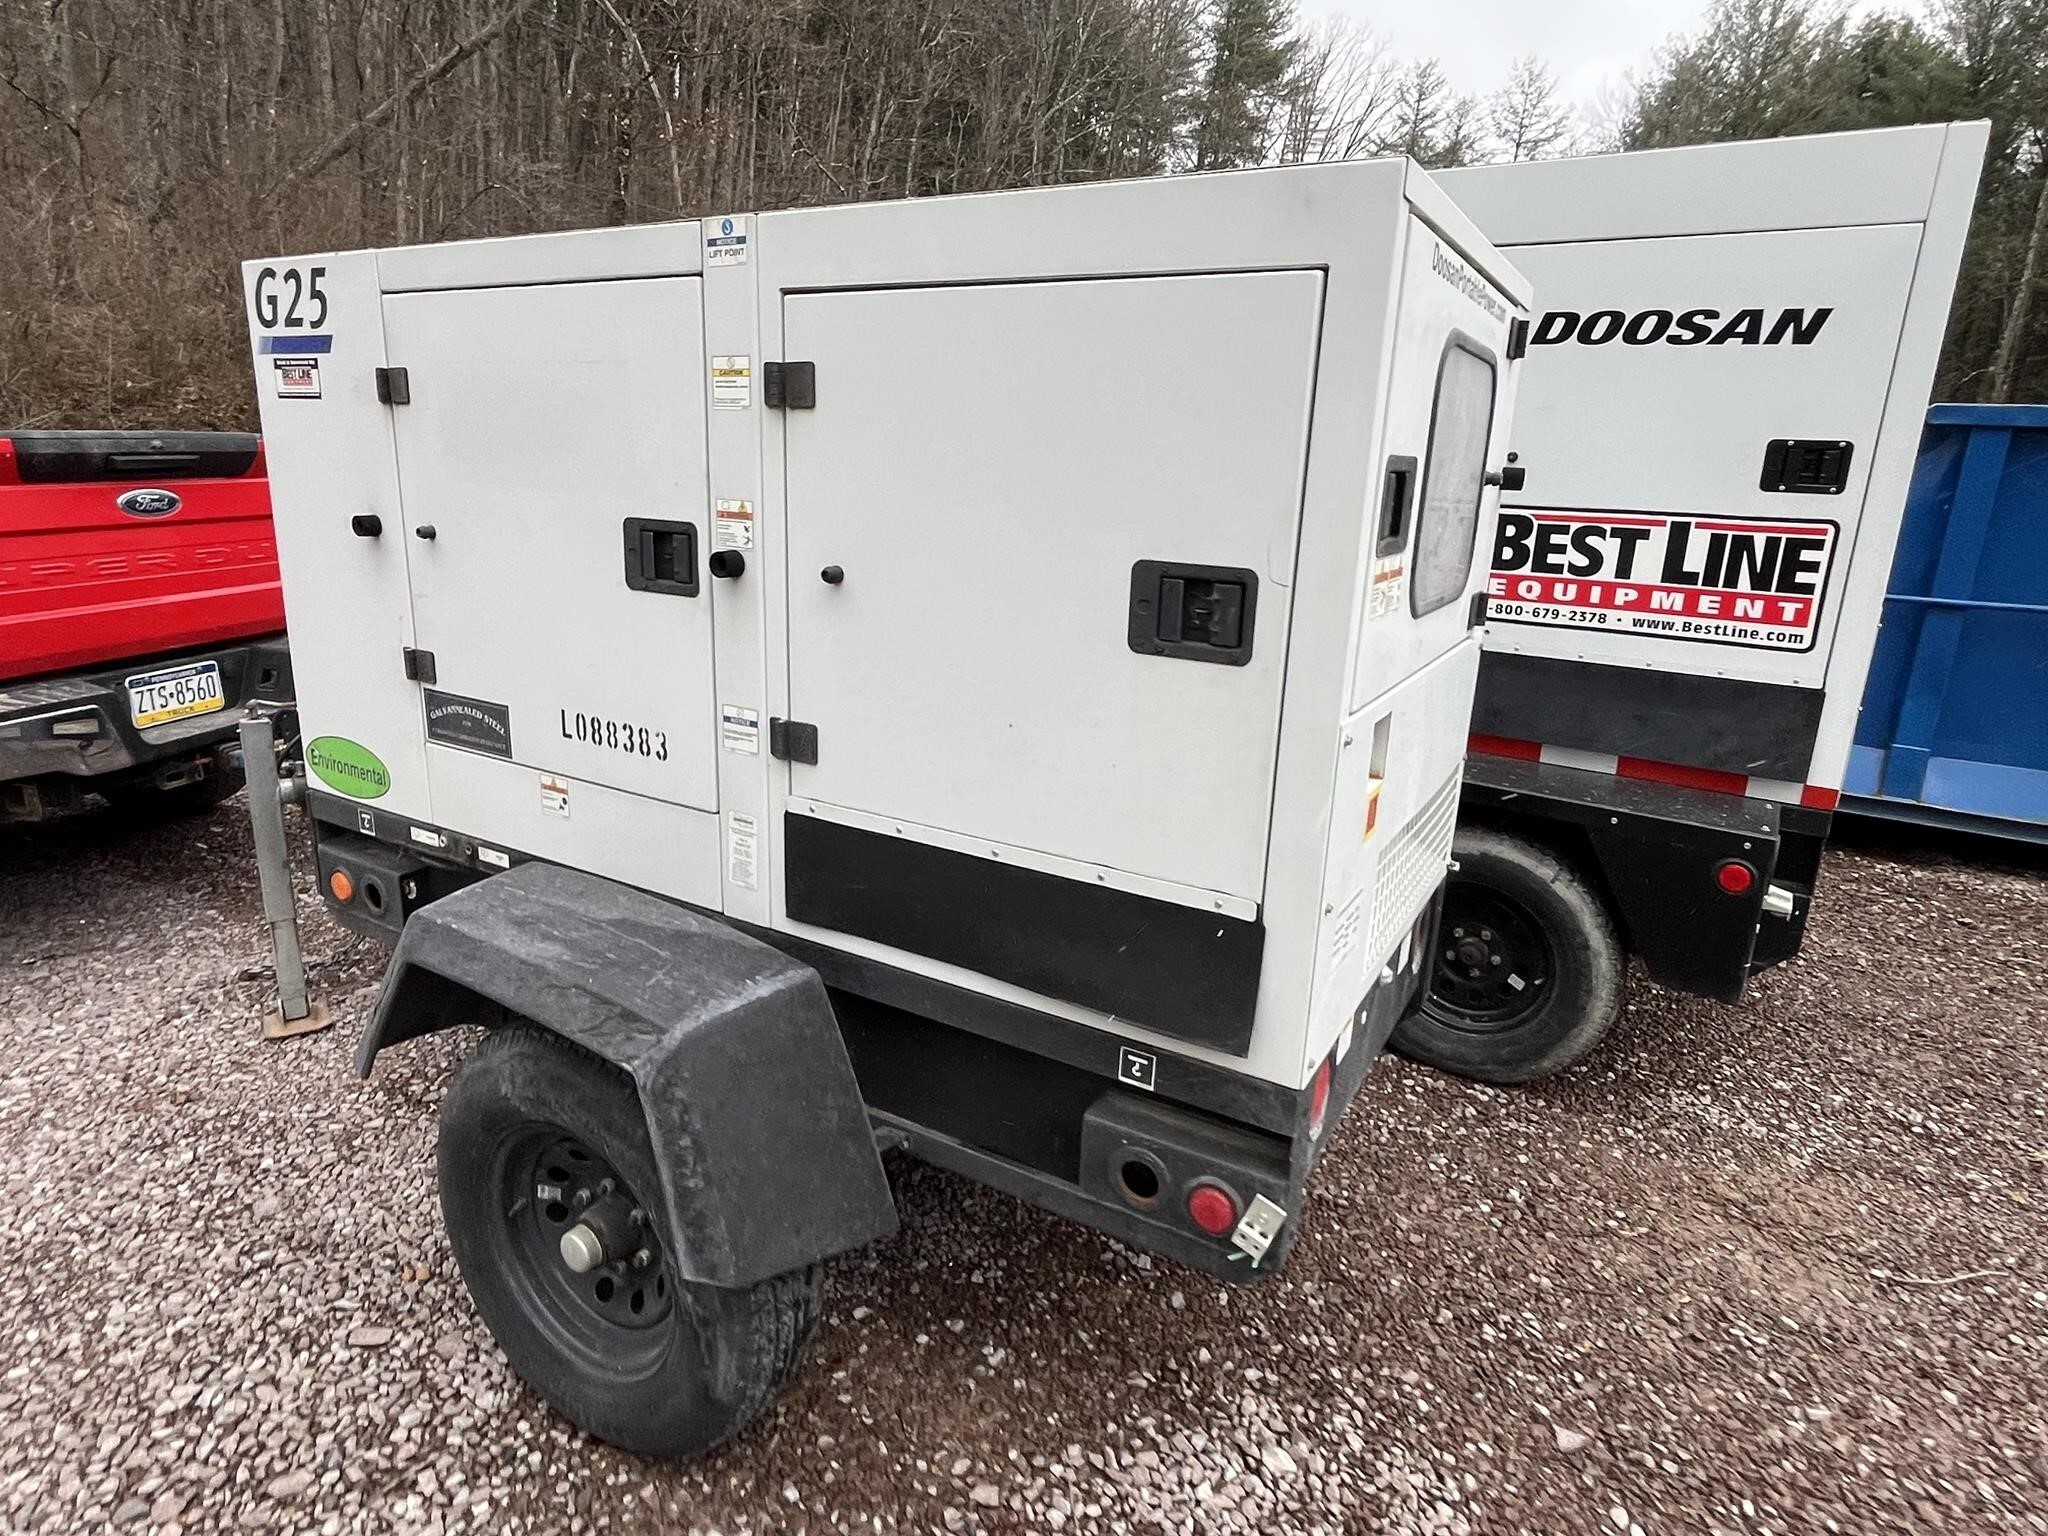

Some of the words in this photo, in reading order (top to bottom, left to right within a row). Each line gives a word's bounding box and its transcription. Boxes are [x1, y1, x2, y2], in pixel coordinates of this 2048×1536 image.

[709, 250, 722, 258] LIFT
[725, 248, 744, 257] POINT
[255, 267, 328, 329] G25
[1530, 308, 1834, 345] DOOSAN
[136, 495, 169, 510] Ford
[1491, 513, 1651, 580] BEST
[1660, 520, 1826, 595] LINE
[1488, 577, 1804, 622] EQUIPMENT
[1632, 617, 1804, 644] www.BestLine.com
[167, 706, 194, 717] TRUCK
[484, 714, 506, 736] STEEL
[561, 709, 668, 761] L088383
[310, 748, 387, 787] Environmental
